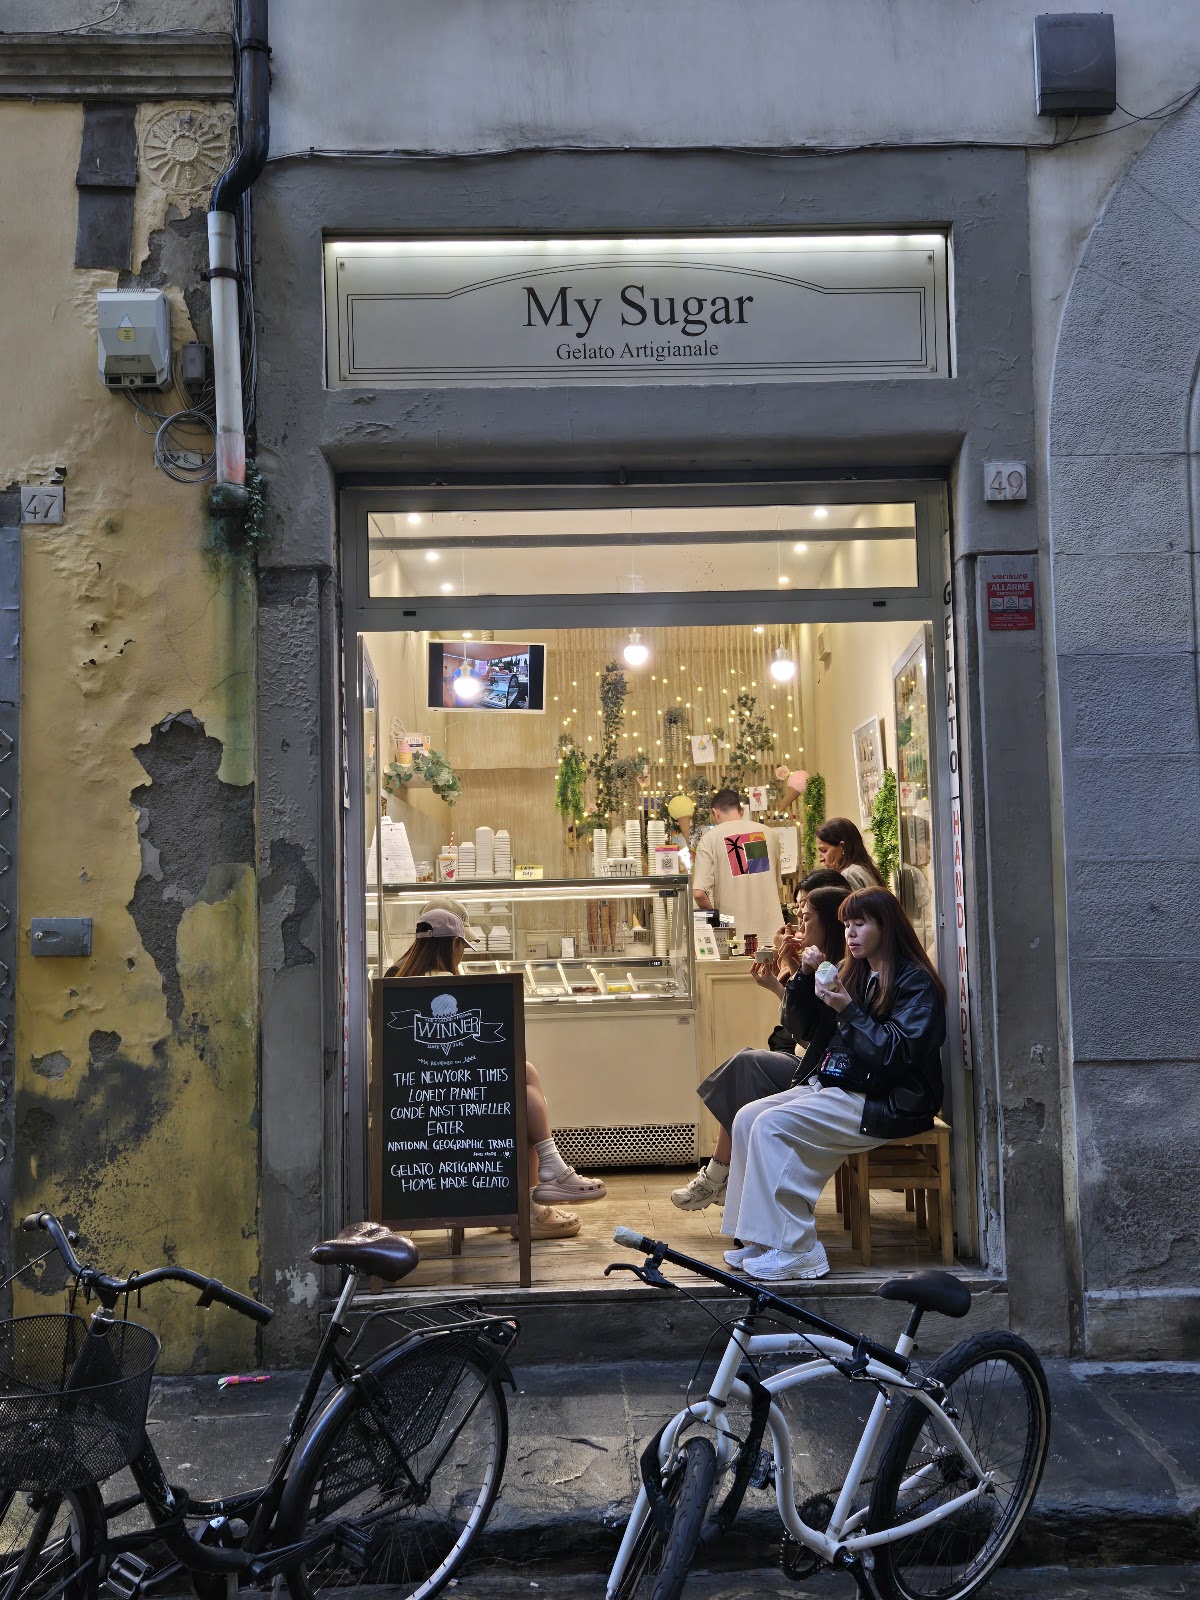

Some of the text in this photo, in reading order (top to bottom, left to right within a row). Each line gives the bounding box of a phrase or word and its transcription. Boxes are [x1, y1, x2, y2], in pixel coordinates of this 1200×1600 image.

[522, 284, 754, 338] My Sugar
[556, 340, 719, 361] Gelato Artigianale
[989, 470, 1024, 498] 49
[24, 494, 59, 520] 47
[991, 583, 1031, 591] ALLARME
[943, 580, 958, 774] GELATO
[953, 809, 969, 1067] HAND MADE
[417, 1016, 479, 1039] WINNER
[393, 1071, 416, 1087] THE
[476, 1067, 509, 1083] TIMES
[408, 1086, 488, 1103] LONELY PLANET
[390, 1101, 511, 1120] CONDÉ NAST TRAVELLER
[427, 1120, 465, 1137] EATER
[387, 1139, 430, 1151] NATIONAL
[487, 1138, 515, 1150] TRAVEL
[390, 1162, 434, 1178] GELATO
[401, 1175, 510, 1193] HOME MADE GELATO
